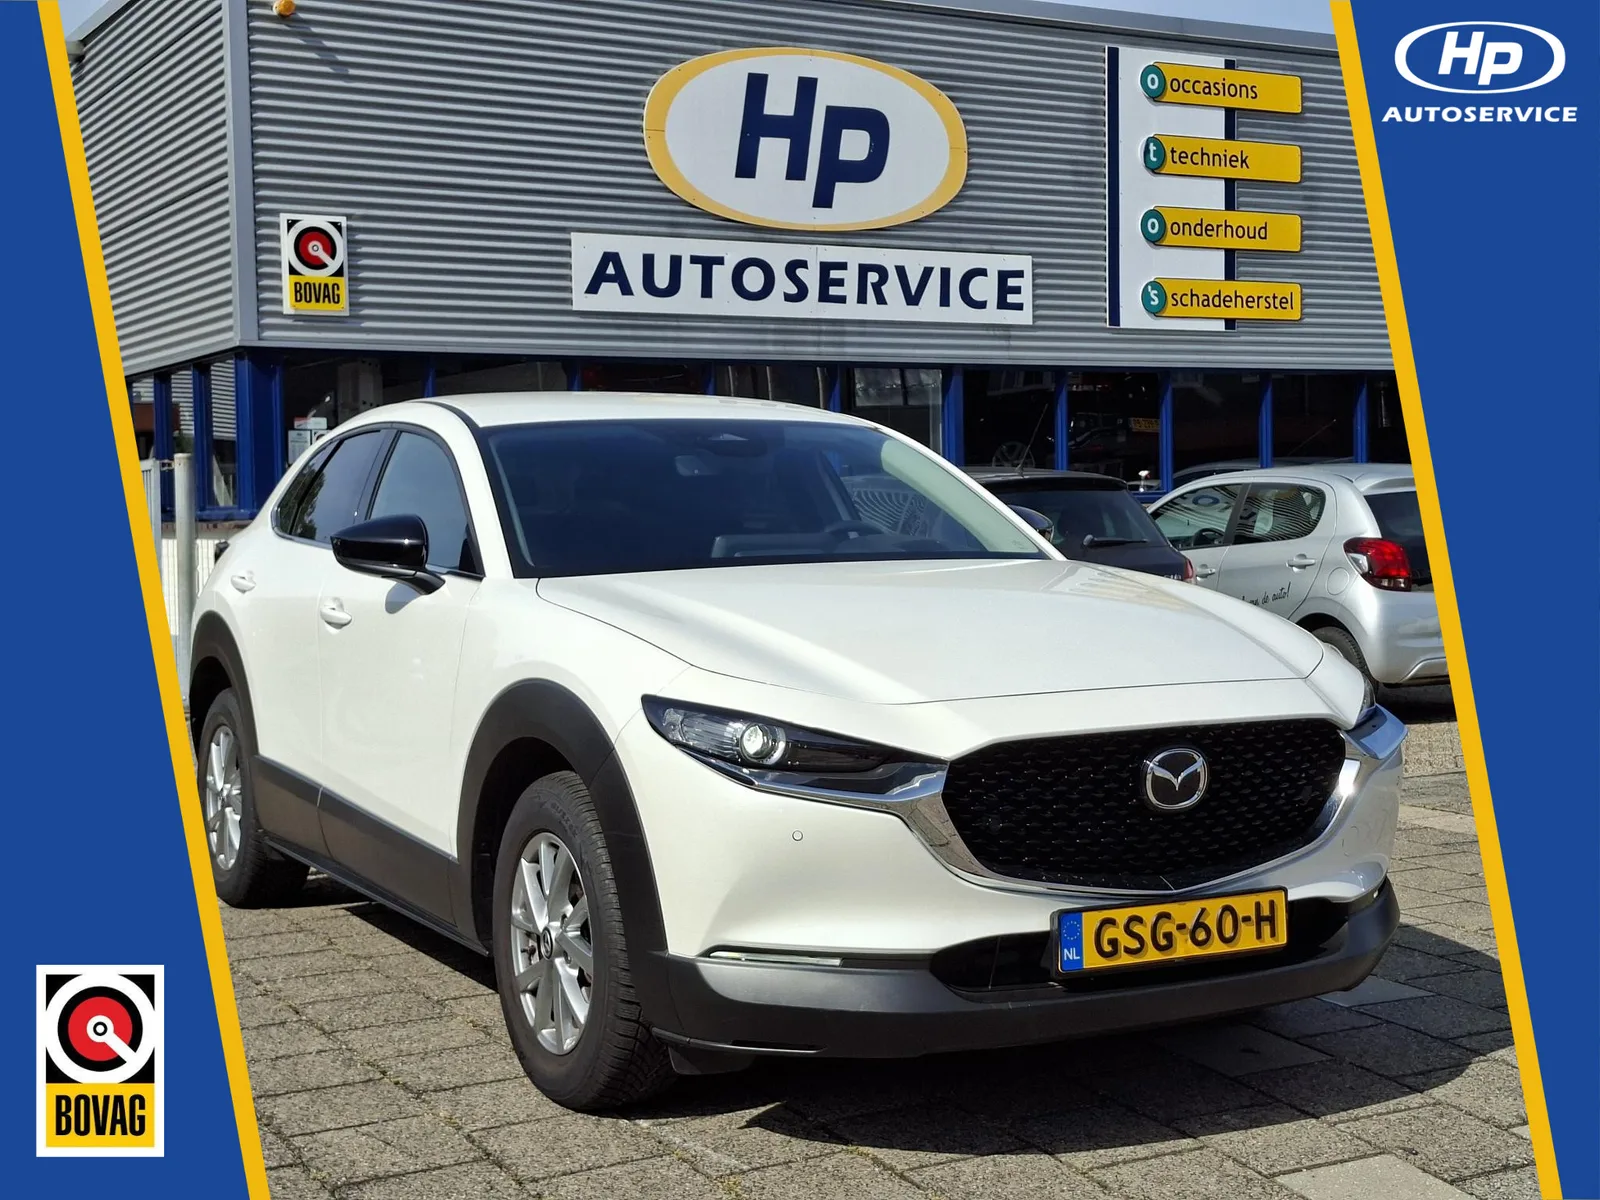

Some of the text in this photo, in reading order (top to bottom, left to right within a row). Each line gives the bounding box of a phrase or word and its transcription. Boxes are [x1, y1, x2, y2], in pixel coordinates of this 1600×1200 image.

[1169, 77, 1259, 100] occasions
[1170, 147, 1250, 170] techniek
[1170, 217, 1268, 240] onderhoud
[293, 281, 341, 305] BOVAG
[584, 251, 1025, 312] AUTOSERVICE
[1170, 288, 1295, 310] schadeherstel
[1093, 899, 1277, 959] GSG-60-H
[1063, 948, 1081, 961] NL
